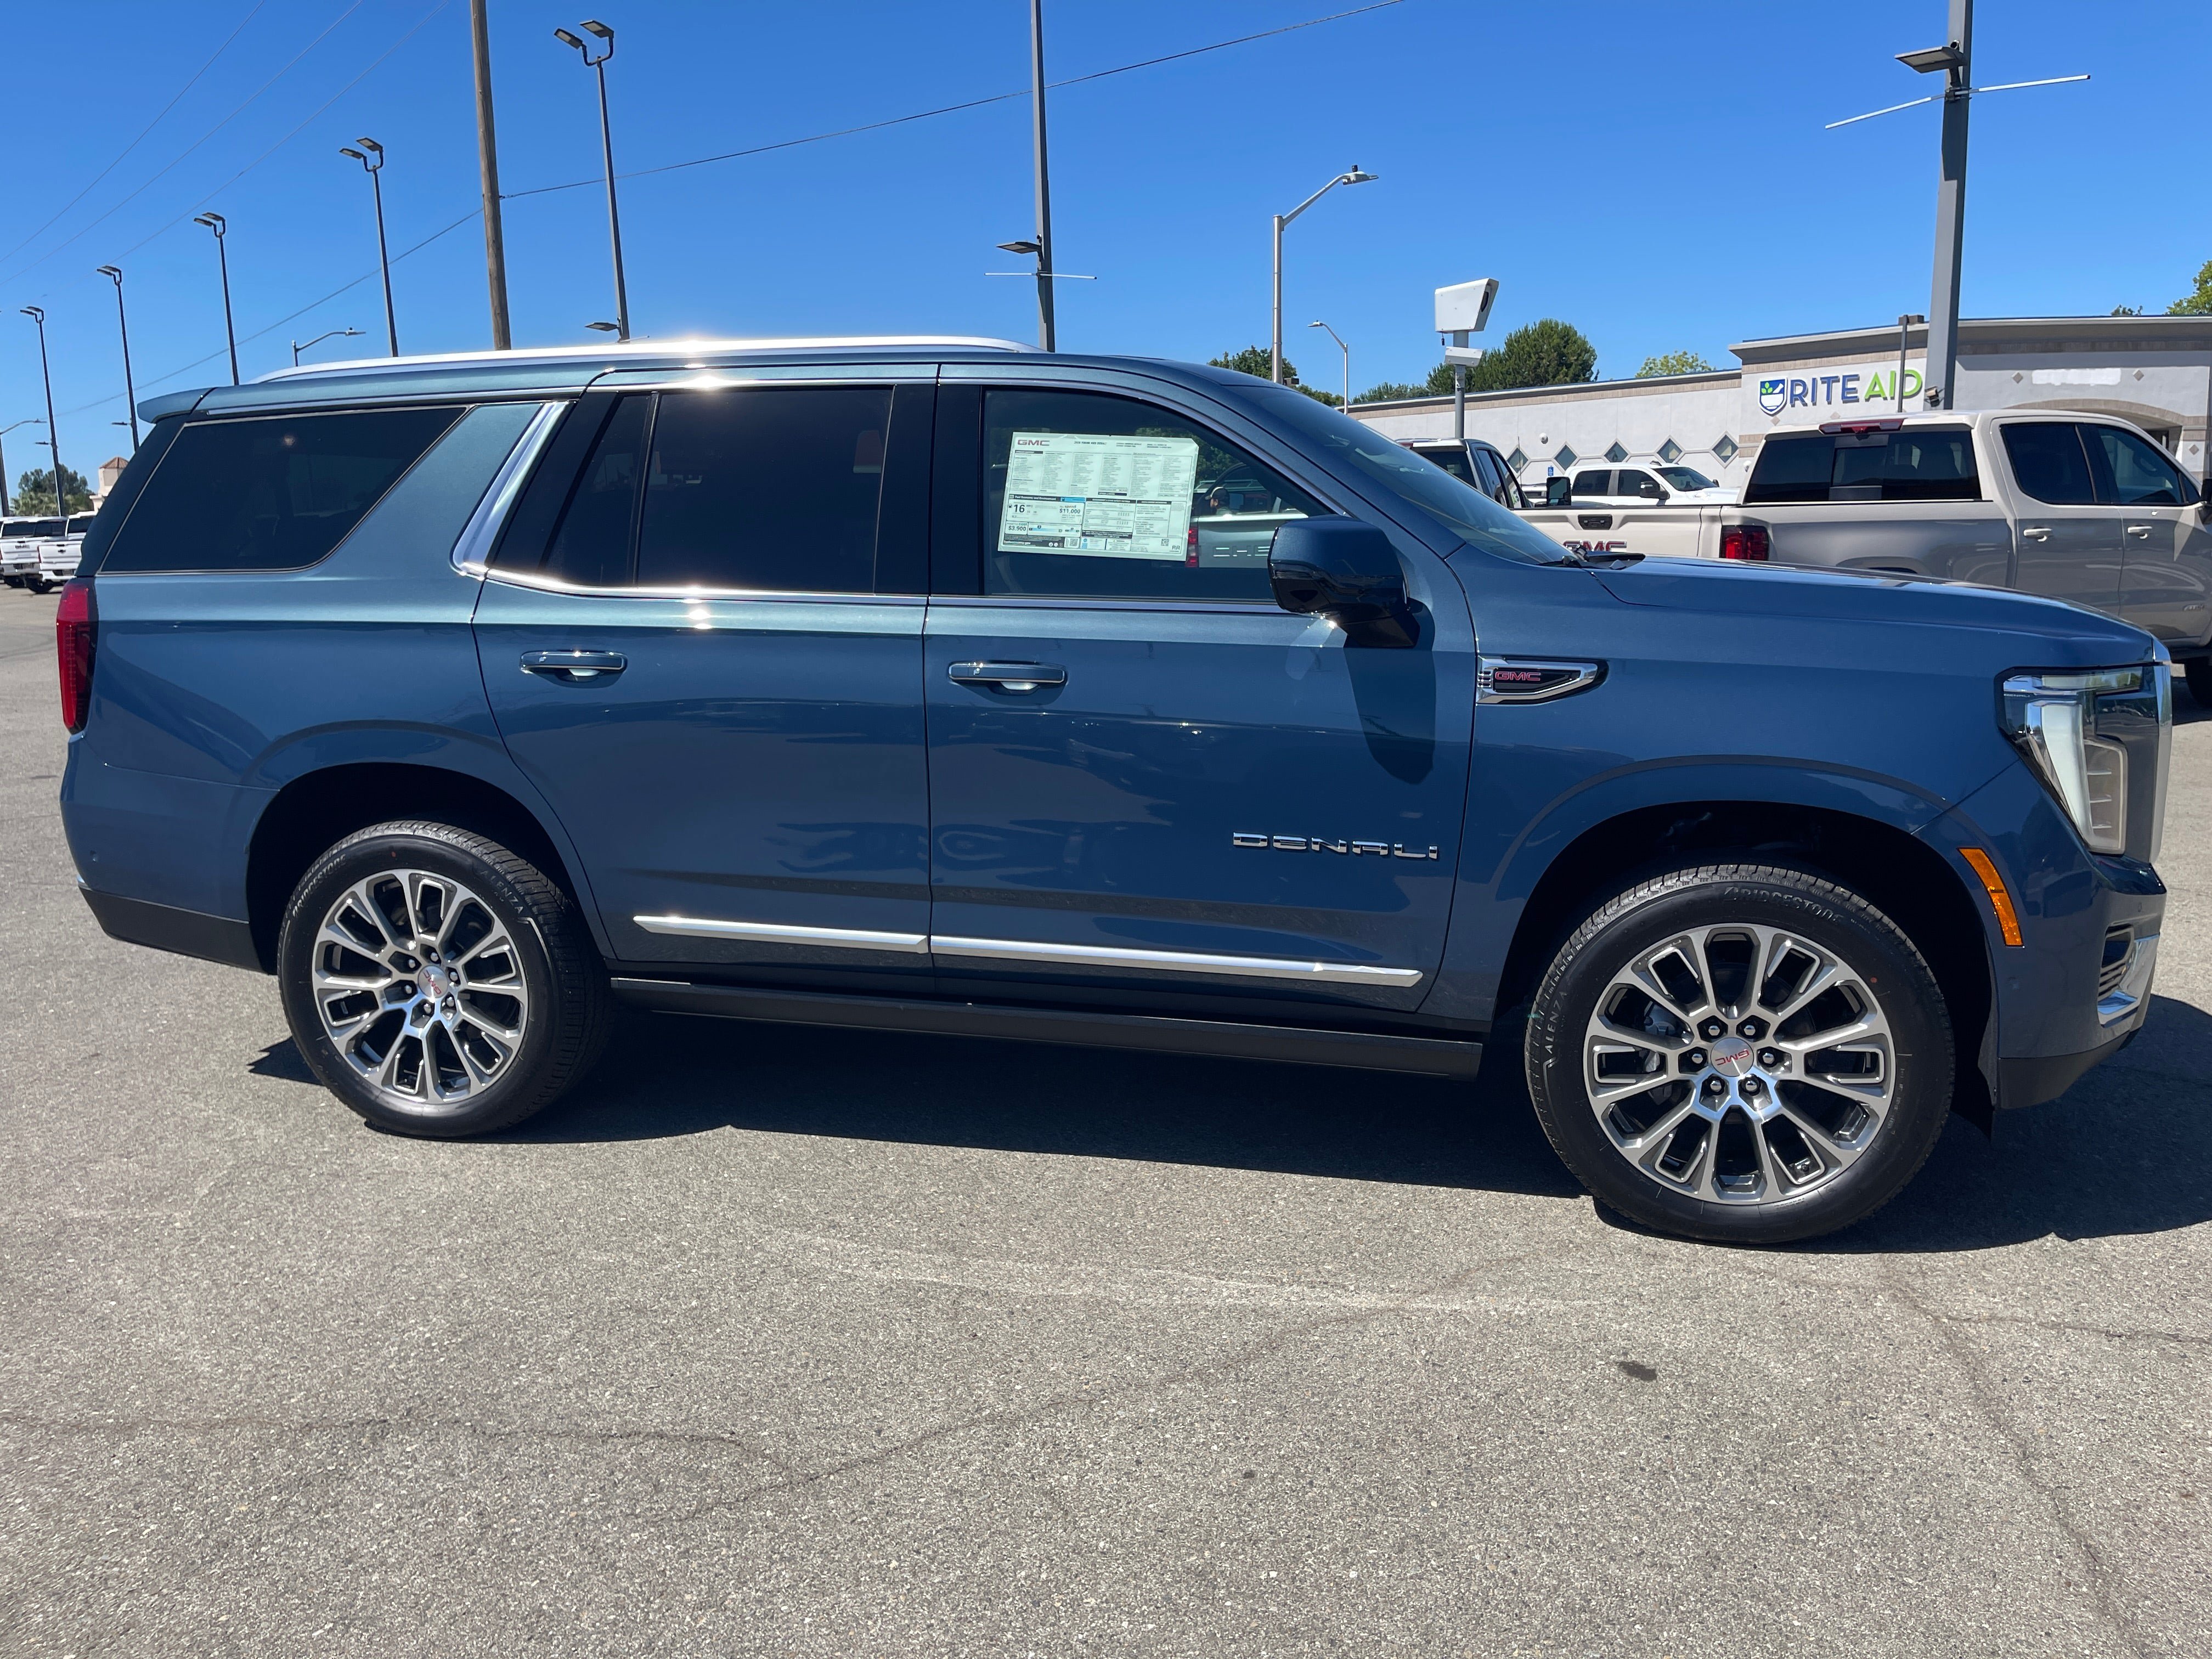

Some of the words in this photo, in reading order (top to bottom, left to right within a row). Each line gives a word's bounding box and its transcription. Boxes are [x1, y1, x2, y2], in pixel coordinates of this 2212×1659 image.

[1790, 374, 1860, 406] RITE
[1864, 369, 1922, 400] AID
[1014, 504, 1025, 513] 16
[1494, 670, 1541, 681] GMC
[1233, 832, 1438, 860] DENALI
[479, 870, 523, 914] ALENZA
[1724, 885, 1844, 922] BRIDGESTONE
[422, 969, 442, 995] GMC
[1544, 991, 1567, 1054] ALENZA
[1715, 1048, 1750, 1066] GMC
